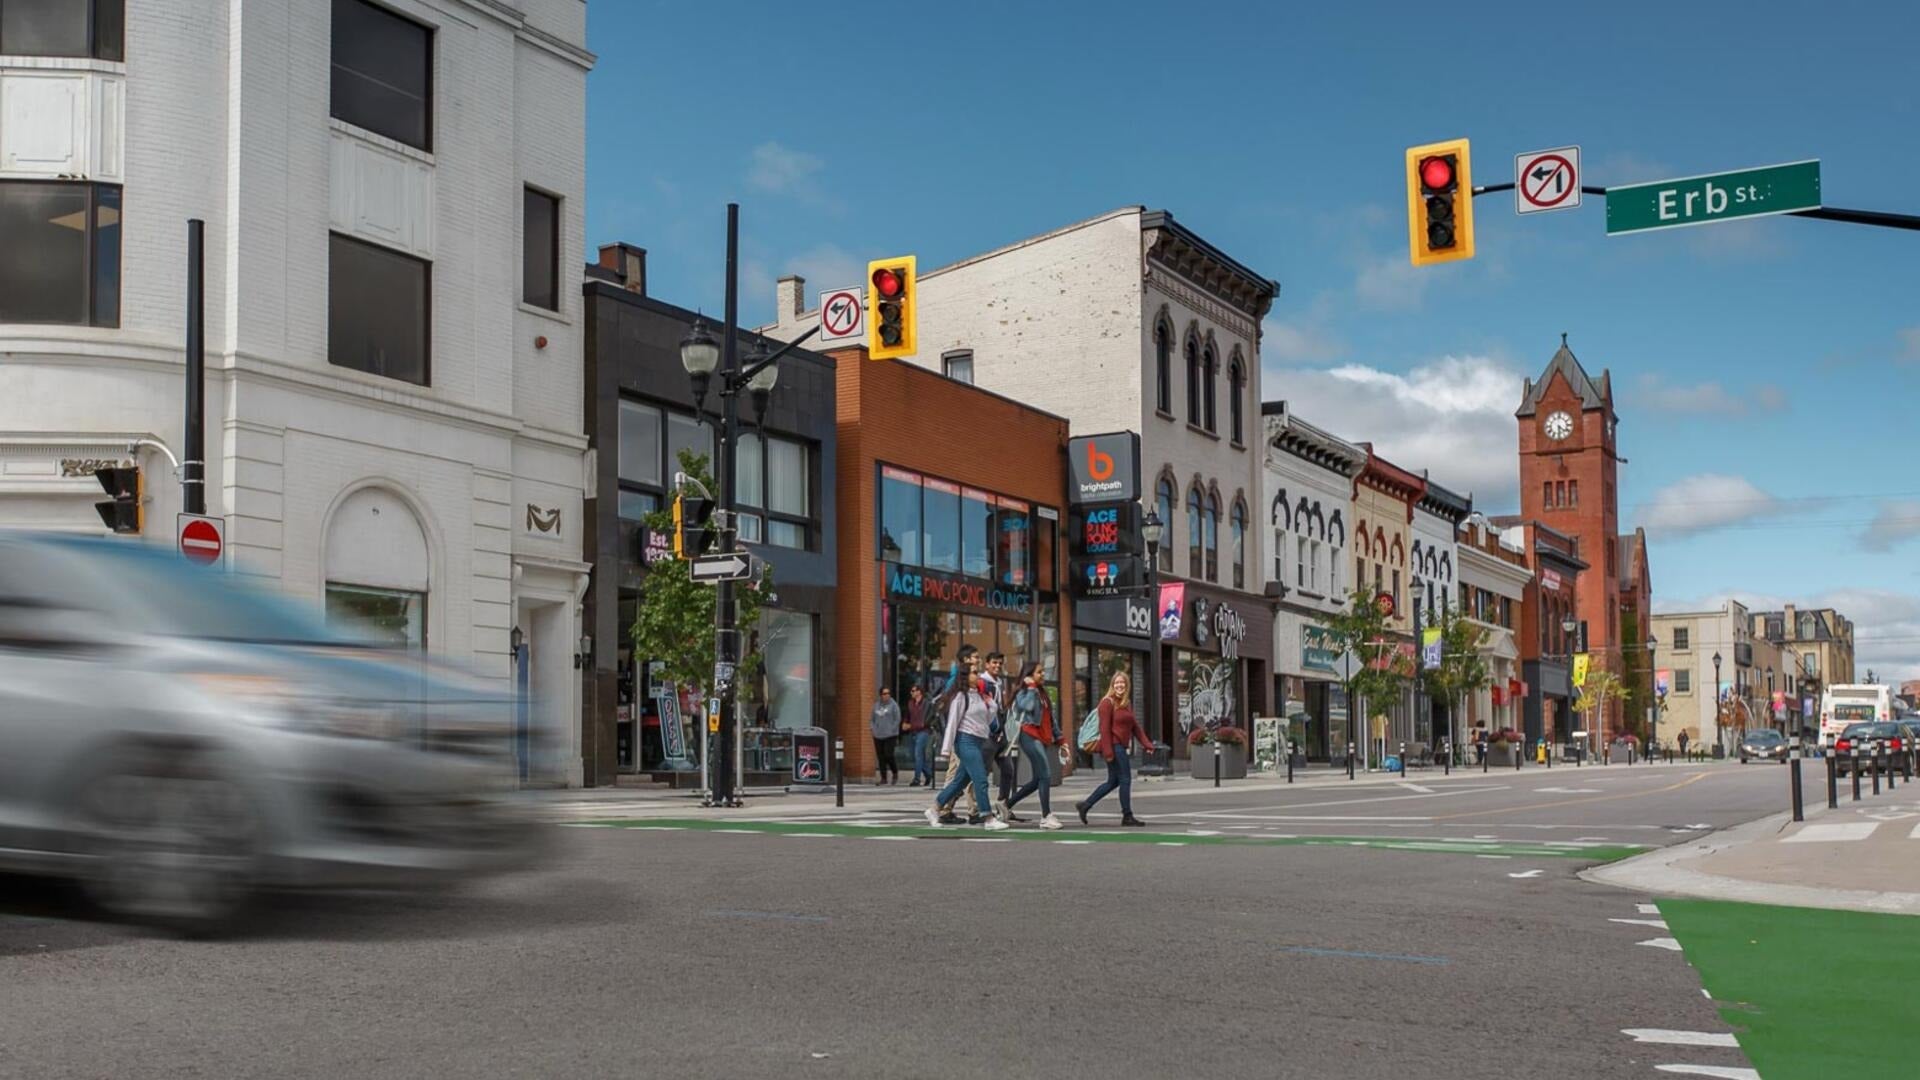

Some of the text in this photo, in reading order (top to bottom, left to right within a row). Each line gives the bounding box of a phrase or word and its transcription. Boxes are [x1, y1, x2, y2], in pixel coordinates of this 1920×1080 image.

[1658, 182, 1728, 220] Erb
[1081, 481, 1122, 491] brightpath
[1088, 510, 1118, 522] ACE
[1087, 522, 1118, 534] PING
[1087, 533, 1118, 545] PONG
[1087, 544, 1118, 553] LOUNGE
[891, 572, 1030, 614] ACE PING PONG LOUNGE
